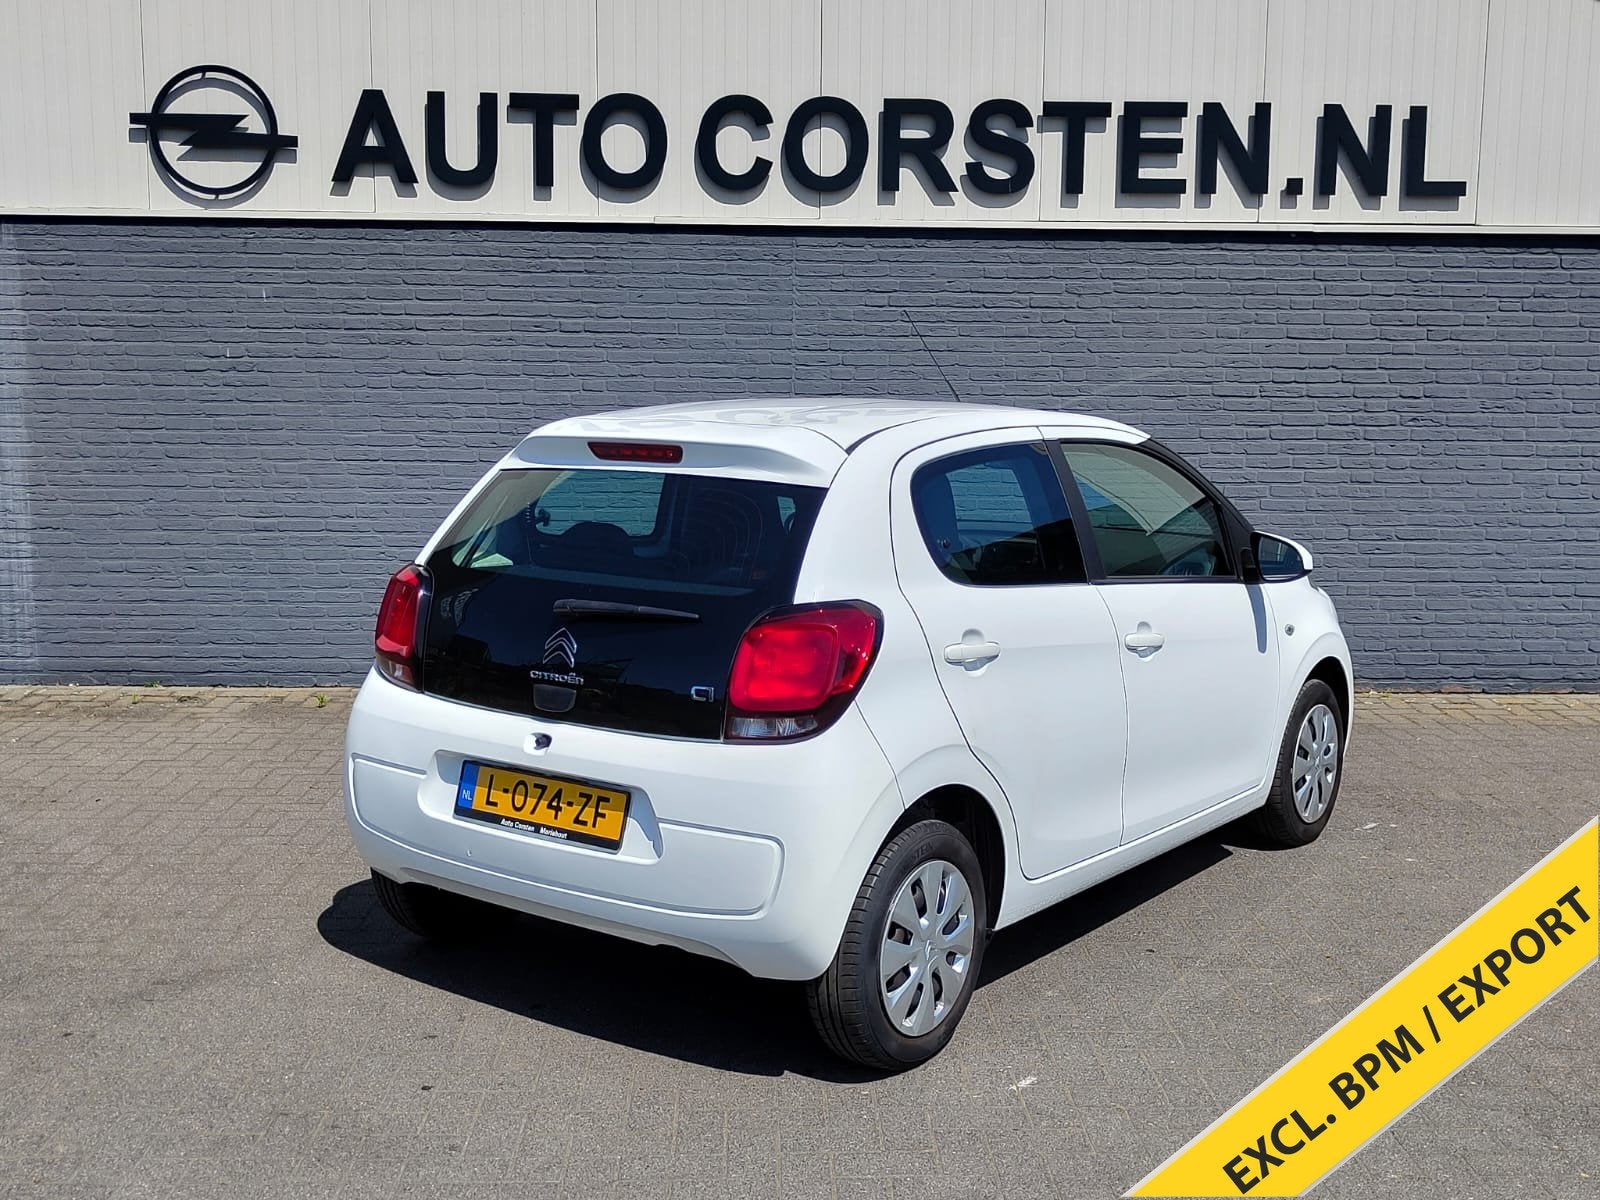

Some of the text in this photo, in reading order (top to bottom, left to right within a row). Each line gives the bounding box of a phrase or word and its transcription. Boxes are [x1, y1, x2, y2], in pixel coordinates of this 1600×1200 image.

[332, 89, 1467, 197] AUTO CORSTEN.NL
[690, 685, 714, 703] C1
[462, 789, 473, 801] NL
[485, 773, 611, 829] L-074-ZF
[500, 818, 514, 827] Auto
